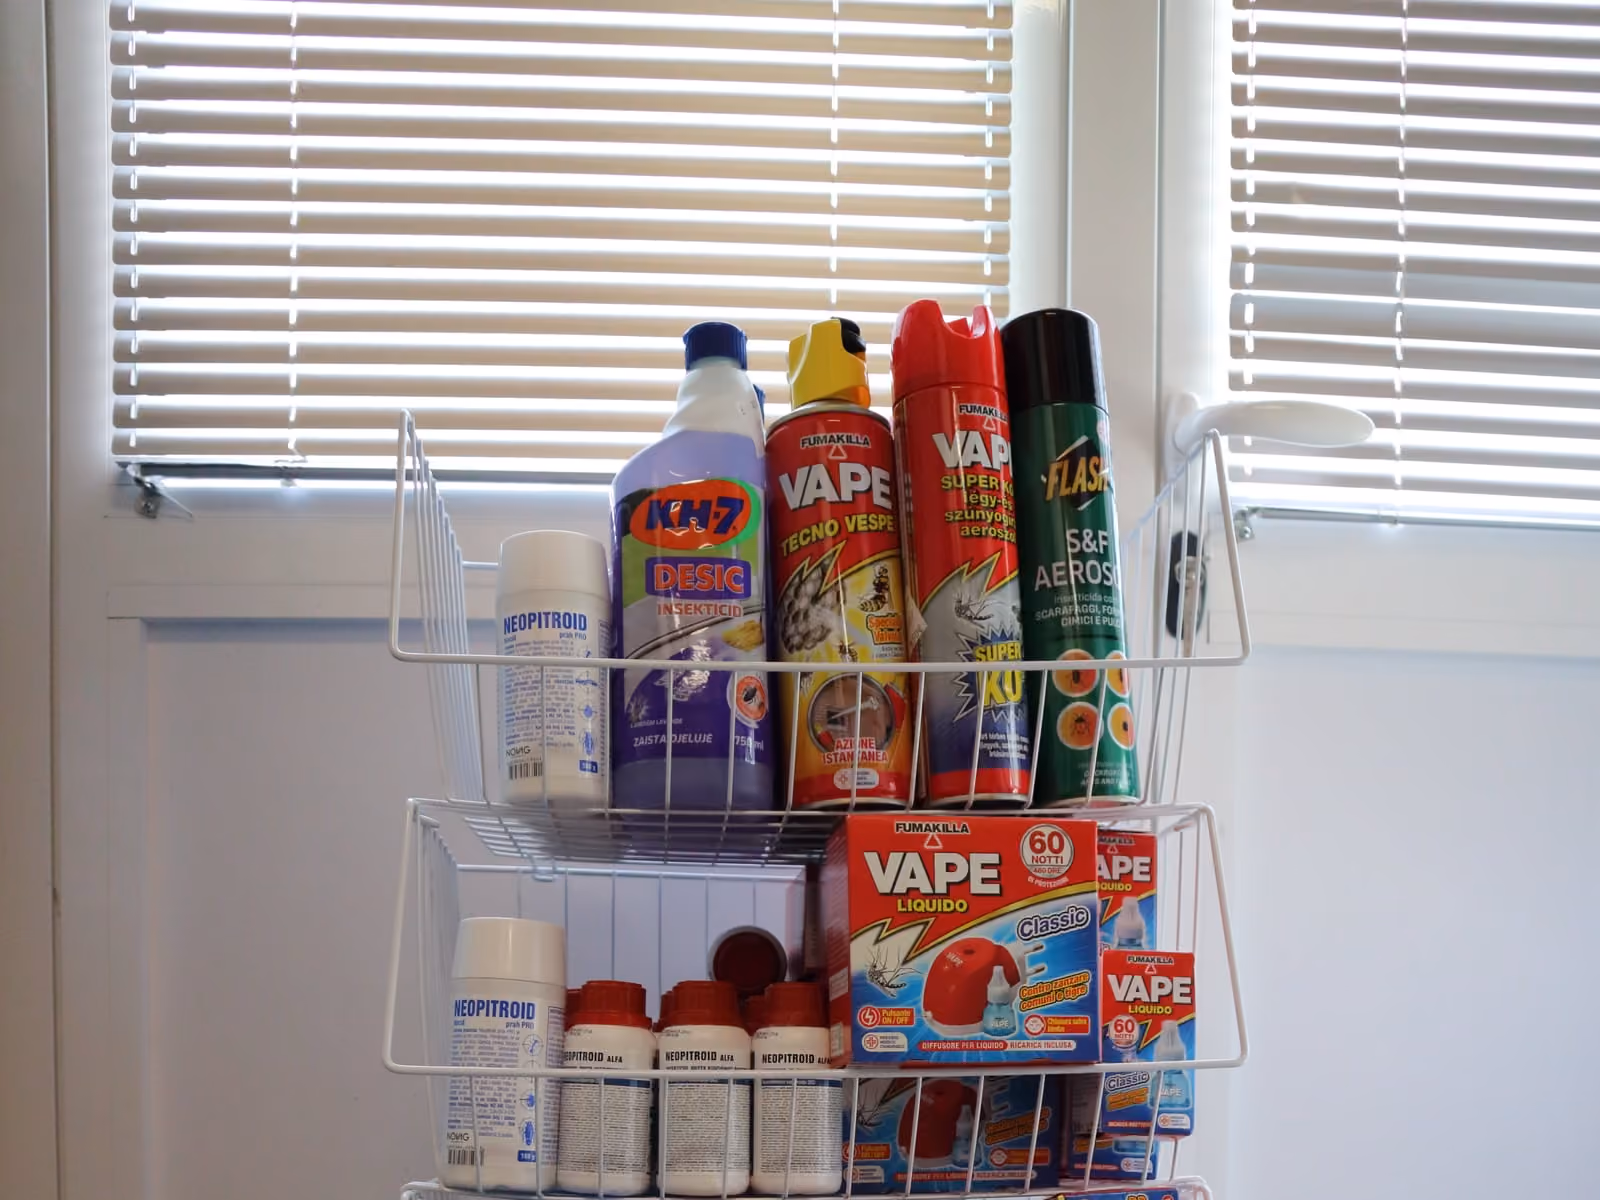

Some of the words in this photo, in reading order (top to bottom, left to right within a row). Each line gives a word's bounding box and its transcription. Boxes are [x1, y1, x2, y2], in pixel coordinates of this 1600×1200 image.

[800, 432, 871, 449] FUMAKILLA
[779, 462, 892, 511] VAPE
[941, 474, 1000, 491] SUPER
[1046, 456, 1110, 501] FLASH
[645, 496, 744, 535] KH-7
[782, 519, 839, 557] TECNO
[844, 514, 896, 533] VESPE
[654, 563, 744, 594] DESIC
[657, 603, 742, 617] INSEKTICID
[503, 611, 587, 635] NEOPITROID
[975, 641, 1022, 662] SUPER
[979, 670, 1022, 706] KO
[633, 734, 667, 747] ZAISTA
[834, 738, 875, 750] AZINE
[822, 751, 888, 764] ISTANANEA
[895, 822, 971, 834] FUMAKILLA
[1029, 830, 1065, 854] 60
[1031, 855, 1064, 865] NOTTI
[1097, 854, 1151, 882] APE
[863, 851, 1002, 895] VAPE
[1098, 882, 1133, 892] QUIDO
[897, 898, 969, 913] LIQUIDO
[1019, 906, 1086, 939] Classic
[1127, 955, 1175, 965] FUMAKILLA
[1107, 974, 1193, 1004] VAPE
[453, 999, 536, 1020] NEOPITROID
[1128, 1004, 1173, 1014] LIQUIDO
[505, 1021, 520, 1029] prah
[1113, 1018, 1135, 1034] 60
[922, 1042, 960, 1050] DIFFUSORE
[961, 1042, 975, 1050] PER
[976, 1042, 1004, 1050] LIQUIDO
[1044, 1041, 1073, 1049] INCLUSA
[564, 1051, 604, 1063] EOPITROID
[606, 1055, 623, 1063] ALFA
[665, 1050, 717, 1062] NEOPITROID
[719, 1054, 735, 1062] ALFA
[761, 1053, 815, 1065] NEOPITROID
[1107, 1072, 1148, 1089] Classic
